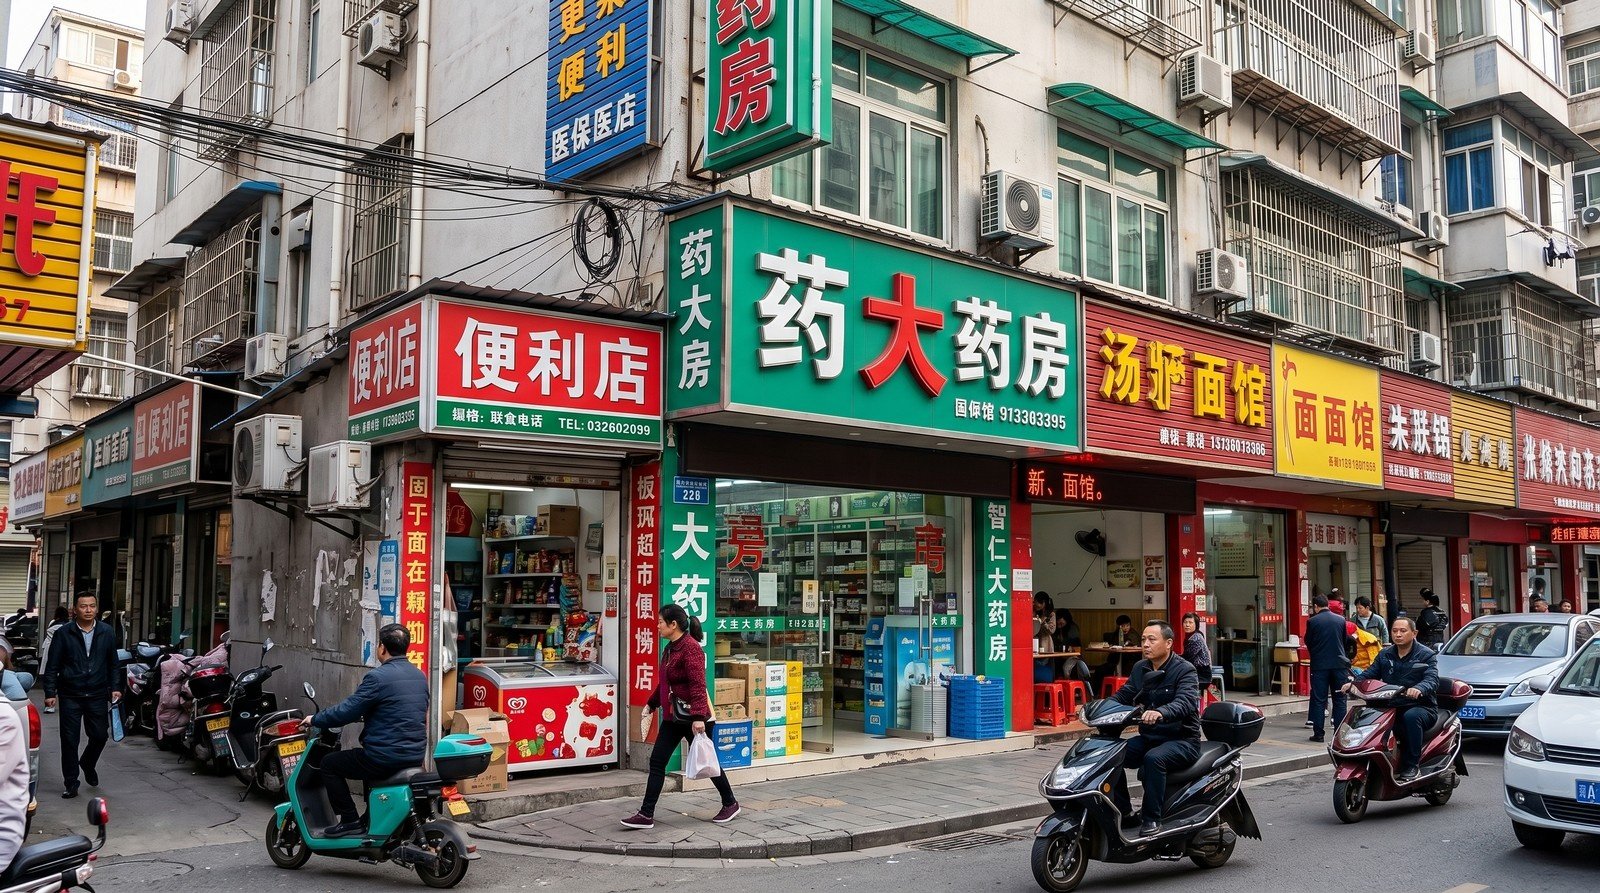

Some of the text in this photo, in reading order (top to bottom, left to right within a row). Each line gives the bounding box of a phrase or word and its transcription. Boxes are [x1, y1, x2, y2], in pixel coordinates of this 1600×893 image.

[557, 23, 626, 102] 便利
[552, 92, 636, 164] 医保医店
[678, 229, 713, 390] 药大房
[755, 248, 1070, 399] 药大药房
[352, 318, 417, 405] 便利店
[454, 316, 648, 405] 便利店
[588, 420, 650, 436] 032602099
[1292, 389, 1375, 451] 面面馆
[683, 489, 701, 501] 228
[987, 502, 1008, 662] 智仁大药房
